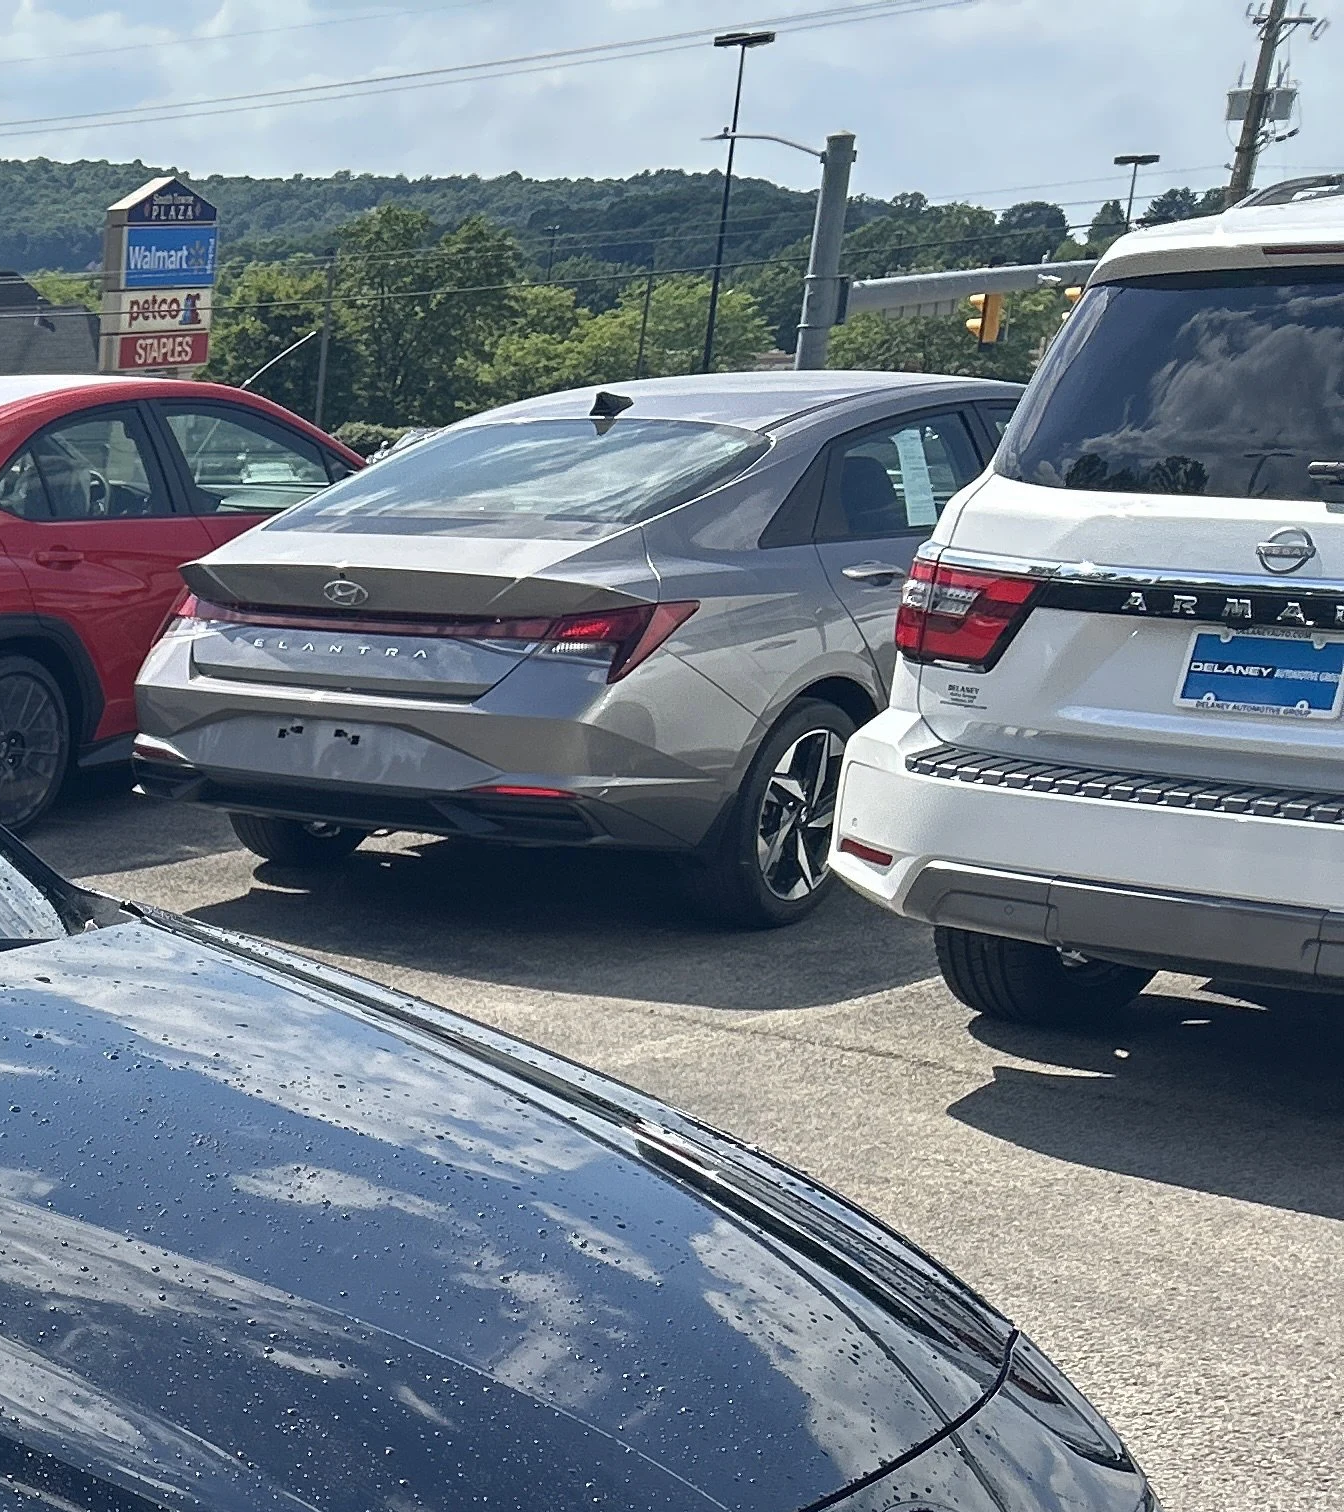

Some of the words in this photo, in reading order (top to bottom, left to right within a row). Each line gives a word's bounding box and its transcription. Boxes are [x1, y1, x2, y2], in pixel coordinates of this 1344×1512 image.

[151, 205, 194, 220] PLAZA
[129, 245, 188, 270] Walmart
[128, 294, 181, 328] petco
[135, 336, 193, 365] STAPLES
[253, 638, 428, 659] ELANTRA
[1190, 661, 1274, 677] DELANEY
[1195, 700, 1231, 711] DELANEY
[1232, 704, 1281, 716] AUTOMOTIVE
